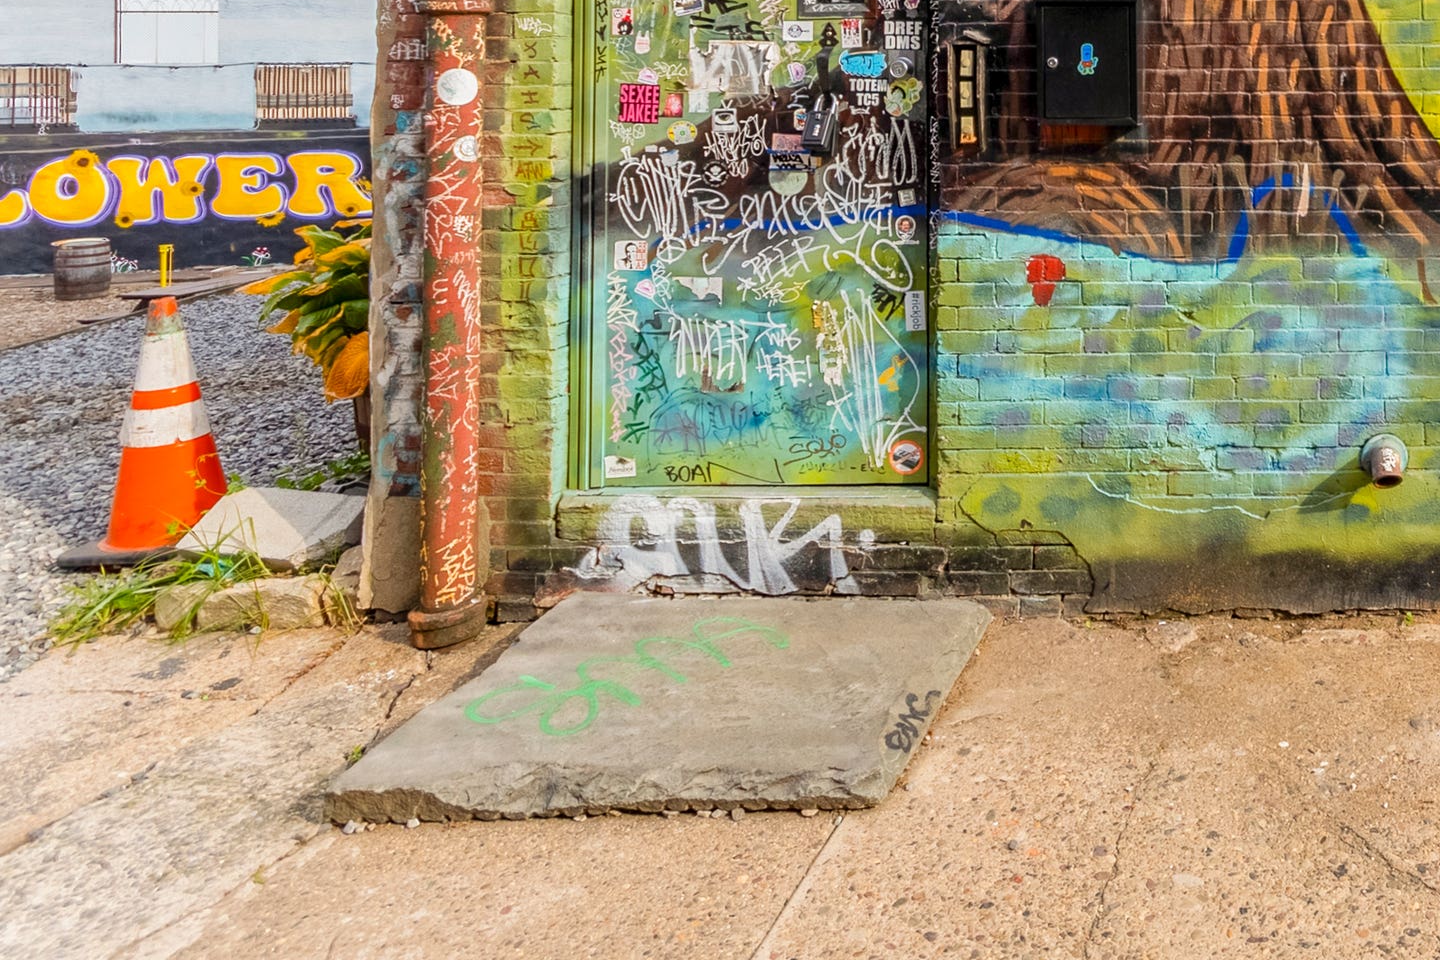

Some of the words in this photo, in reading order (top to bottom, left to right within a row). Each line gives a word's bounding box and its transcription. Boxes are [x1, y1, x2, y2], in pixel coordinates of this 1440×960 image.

[884, 20, 923, 36] DREF
[885, 35, 920, 50] DMS
[620, 84, 660, 103] SEXEE
[849, 78, 887, 93] TOTEM
[855, 92, 880, 107] TC5
[619, 103, 659, 123] JAKEE
[910, 292, 923, 331] #rickjob
